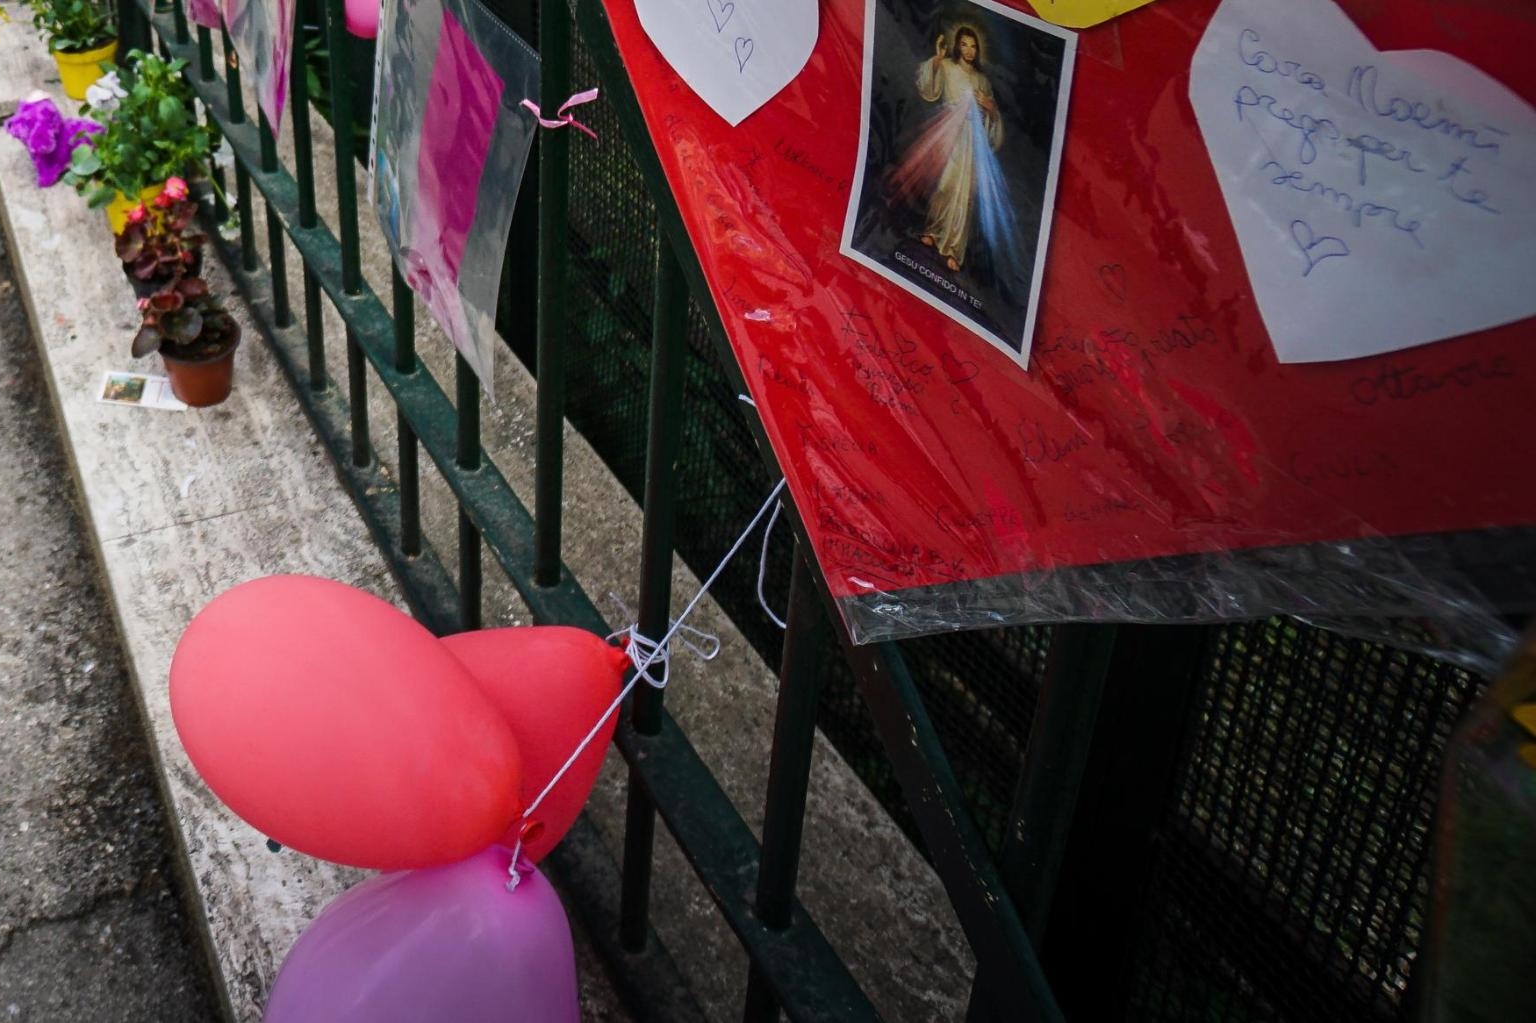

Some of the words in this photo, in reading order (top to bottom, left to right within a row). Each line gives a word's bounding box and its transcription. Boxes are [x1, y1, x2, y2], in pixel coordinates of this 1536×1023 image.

[1238, 28, 1329, 98] Cara
[1346, 64, 1509, 154] Noemi
[1260, 161, 1425, 250] sempre
[1345, 133, 1425, 186] per
[1437, 156, 1501, 215] te
[895, 251, 918, 271] GESU
[919, 265, 957, 294] CONFIDO
[958, 288, 969, 301] IN
